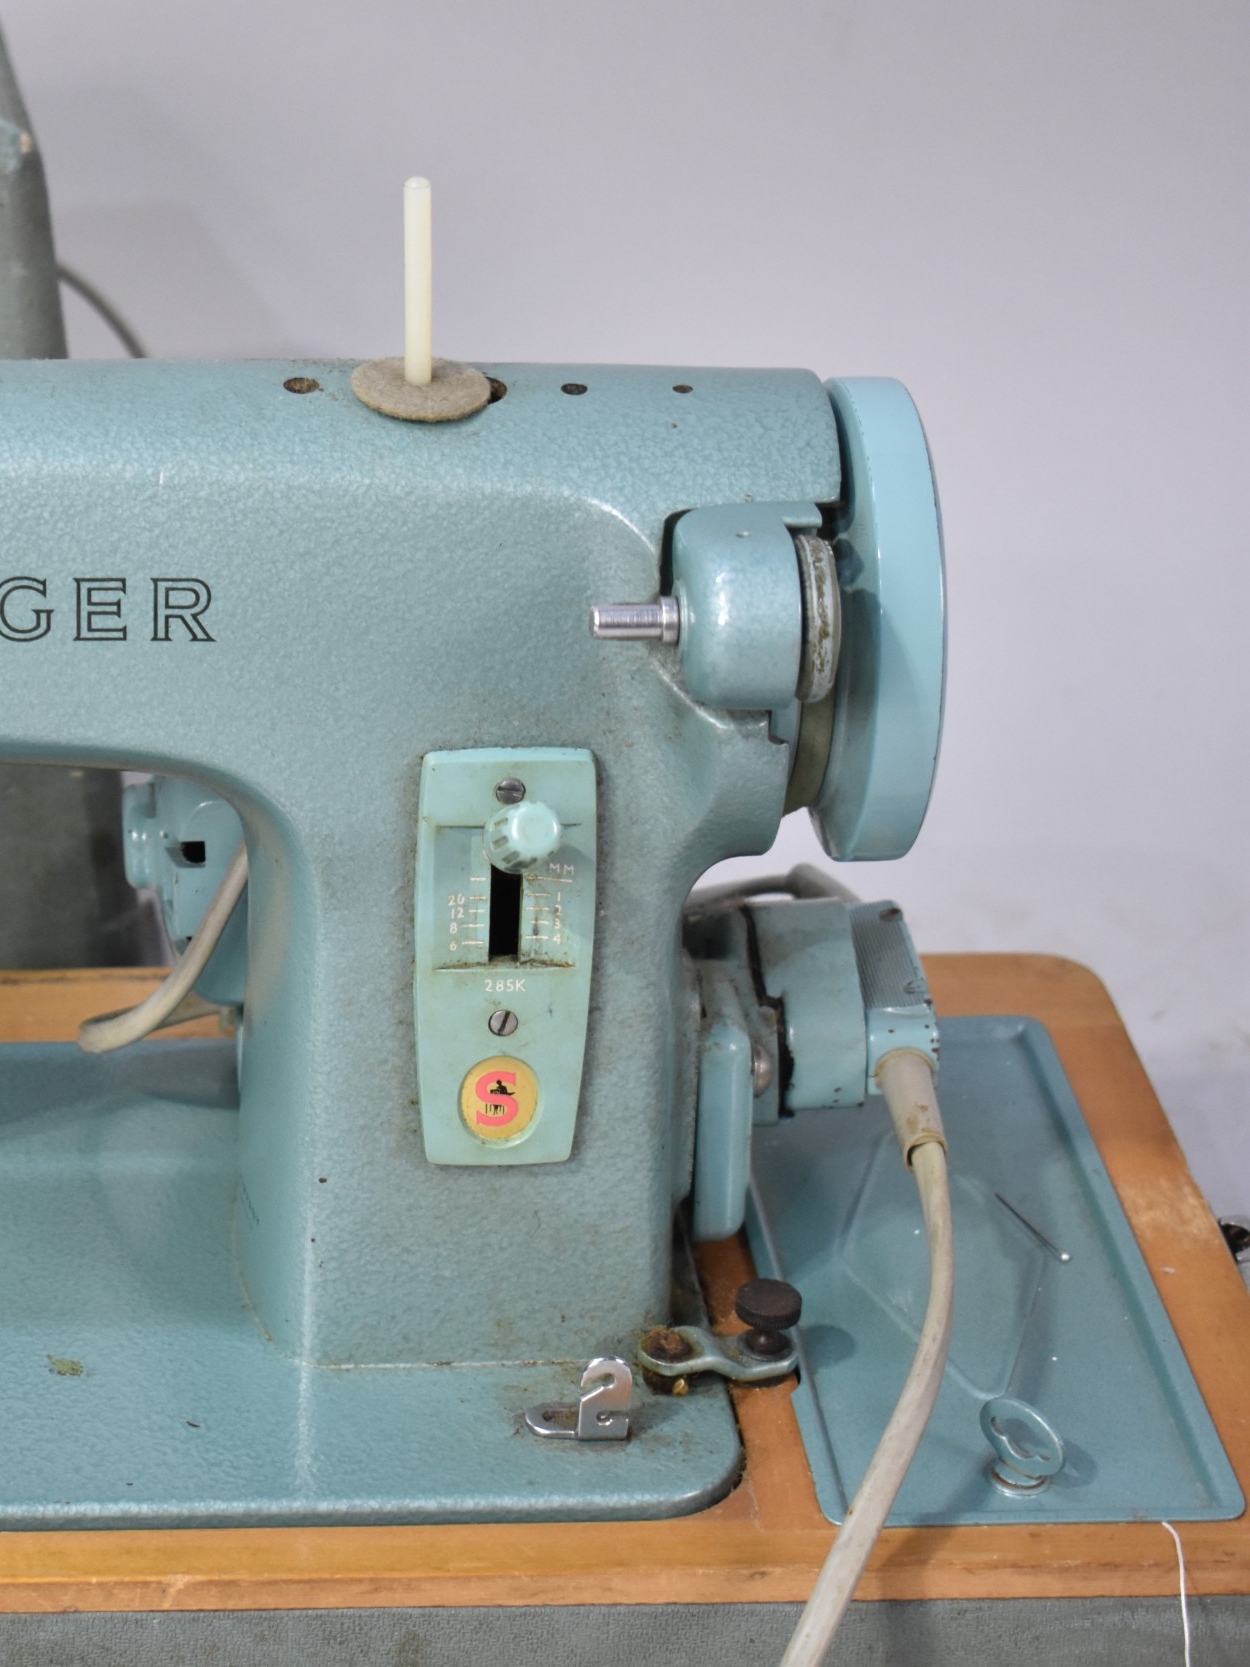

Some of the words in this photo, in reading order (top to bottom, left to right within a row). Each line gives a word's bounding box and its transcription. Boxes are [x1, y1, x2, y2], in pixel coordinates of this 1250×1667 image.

[448, 893, 465, 906] 20
[451, 908, 464, 919] 12
[554, 904, 562, 916] 2
[449, 922, 458, 934] 8
[553, 918, 561, 929] 3
[553, 933, 562, 945] 4
[449, 940, 458, 951] 6
[484, 978, 526, 992] 285K
[475, 1070, 519, 1127] S
